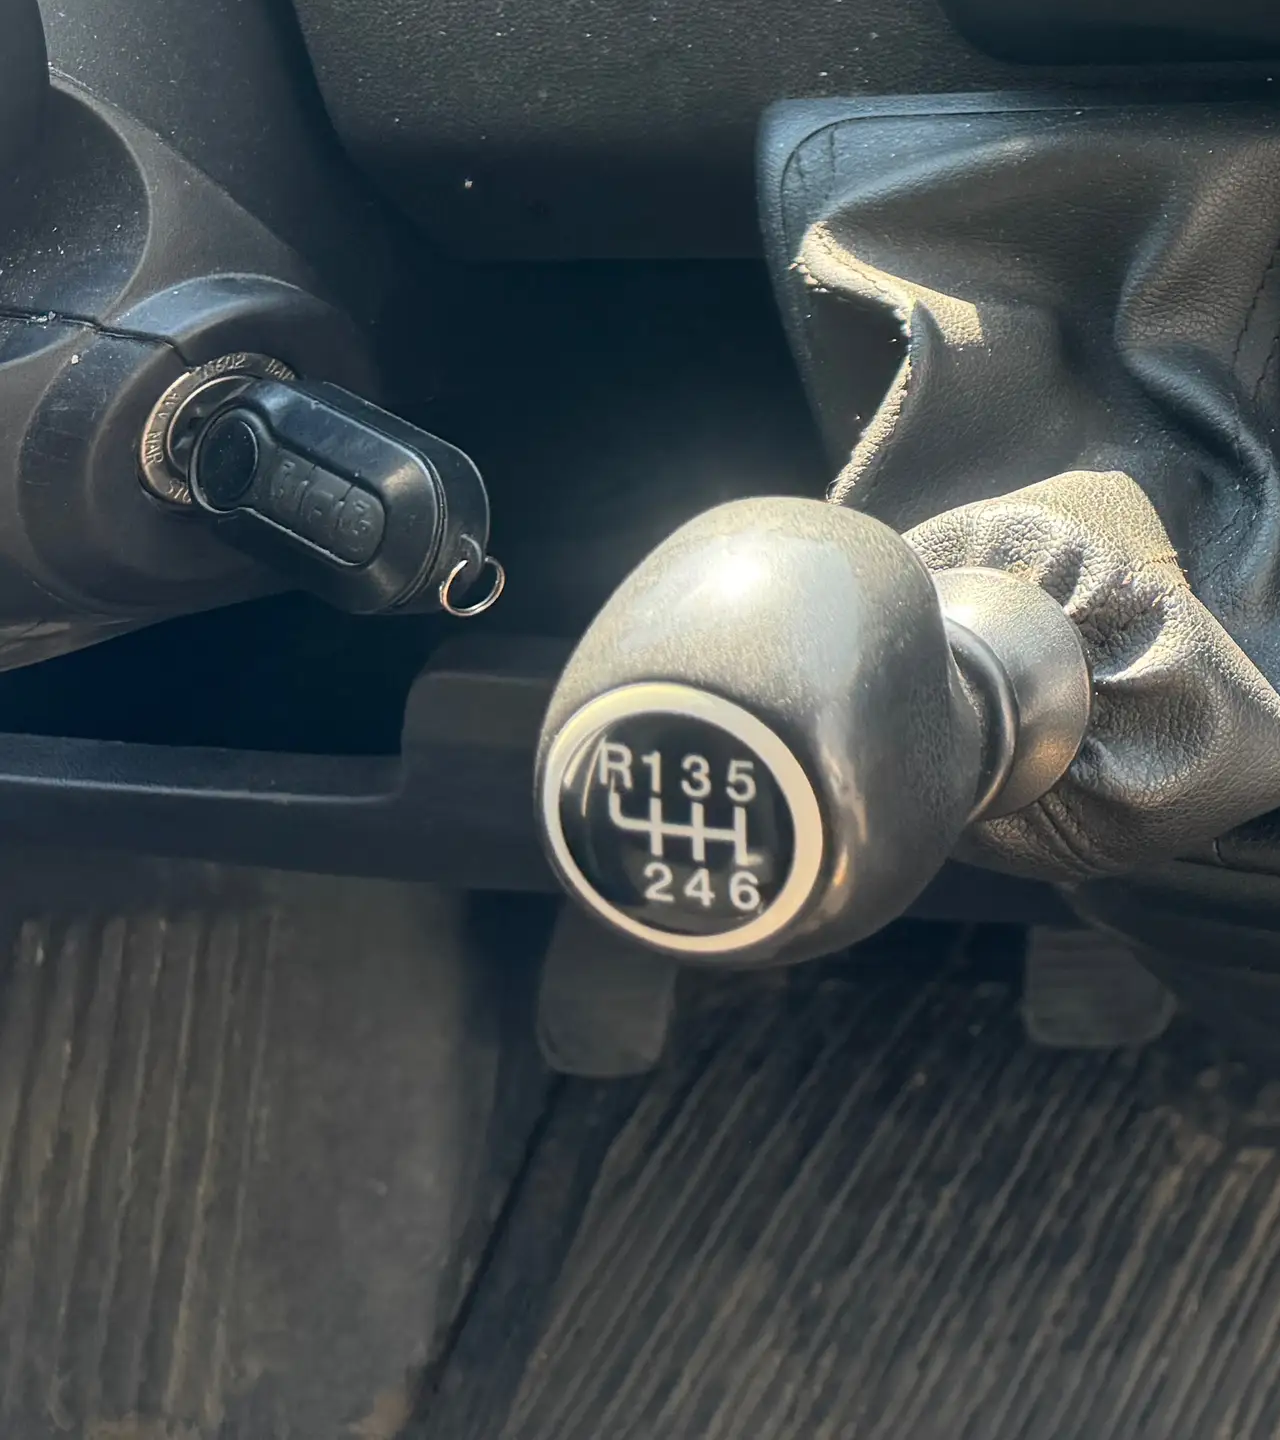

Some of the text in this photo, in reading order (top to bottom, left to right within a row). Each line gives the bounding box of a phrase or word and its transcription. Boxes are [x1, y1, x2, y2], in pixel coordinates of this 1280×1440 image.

[600, 741, 756, 802] R 1 3 5
[644, 863, 760, 909] 2 4 6
